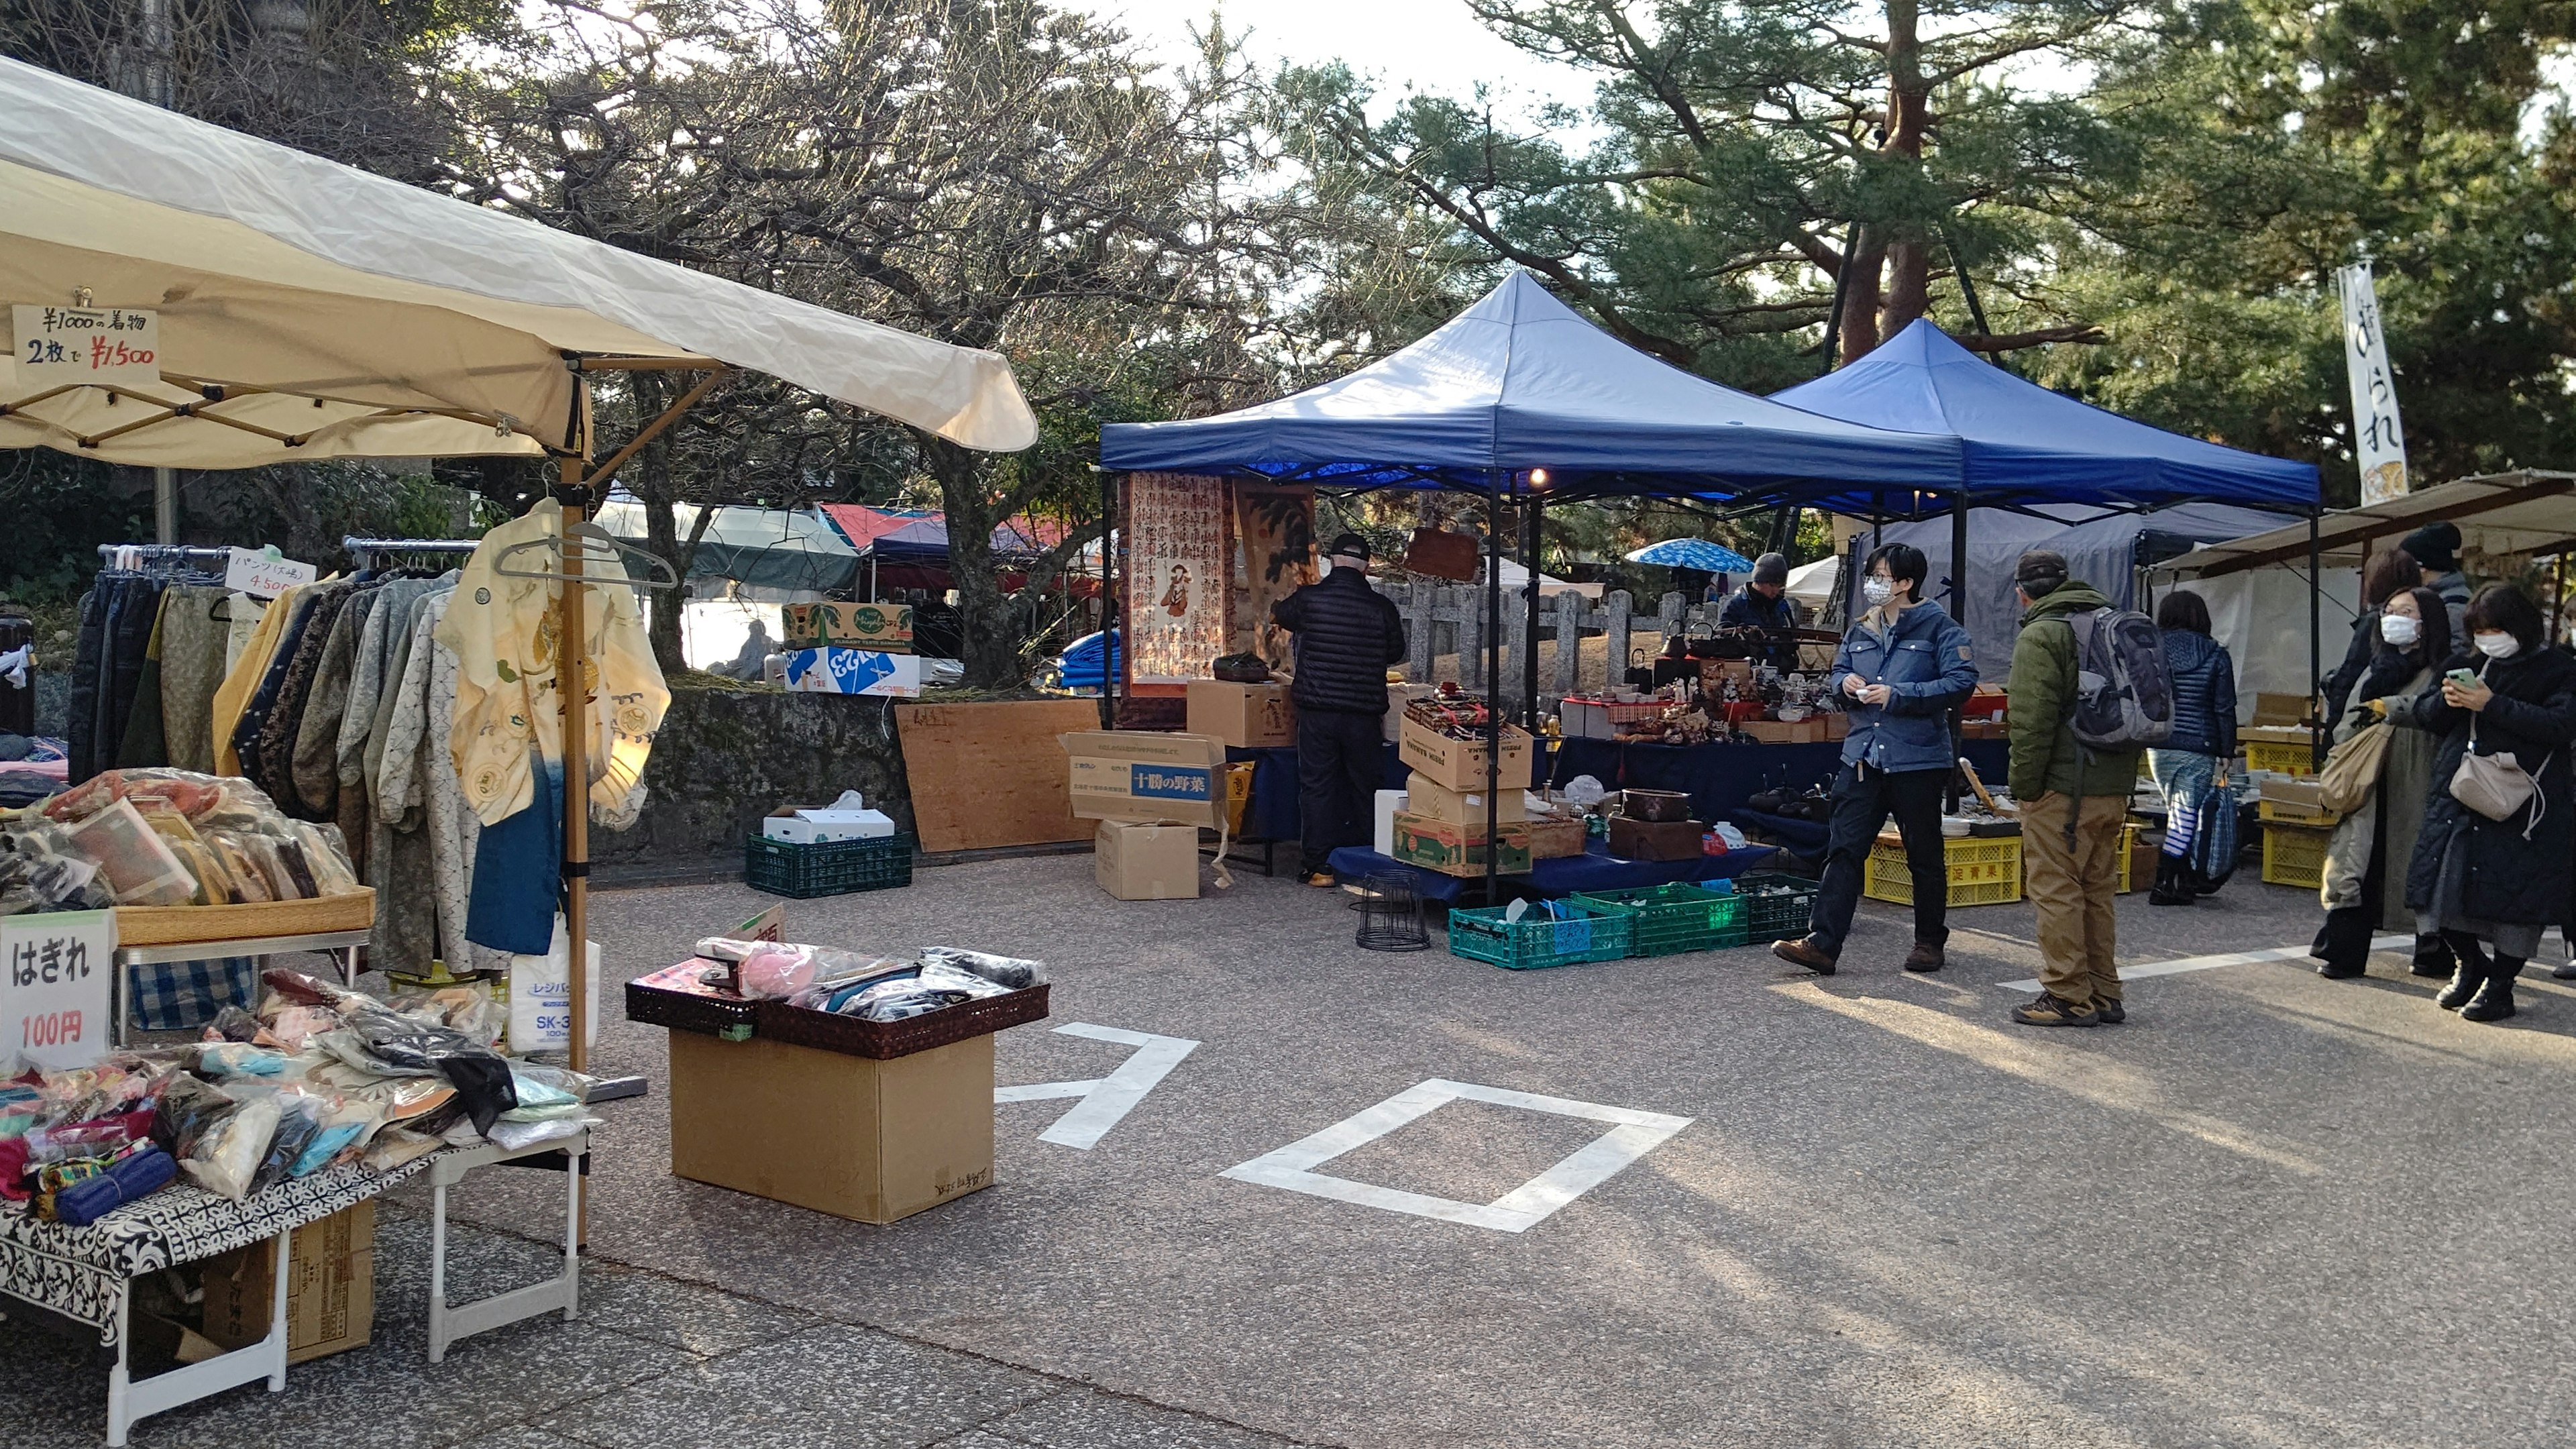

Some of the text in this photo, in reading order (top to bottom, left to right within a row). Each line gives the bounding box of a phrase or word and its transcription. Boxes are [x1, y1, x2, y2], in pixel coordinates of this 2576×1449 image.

[1134, 773, 1205, 793] 十勝の野菜
[1952, 865, 1998, 881] 淀青果
[13, 936, 90, 987] はぎれ
[22, 1010, 82, 1049] 100円
[537, 1016, 570, 1029] SK-3
